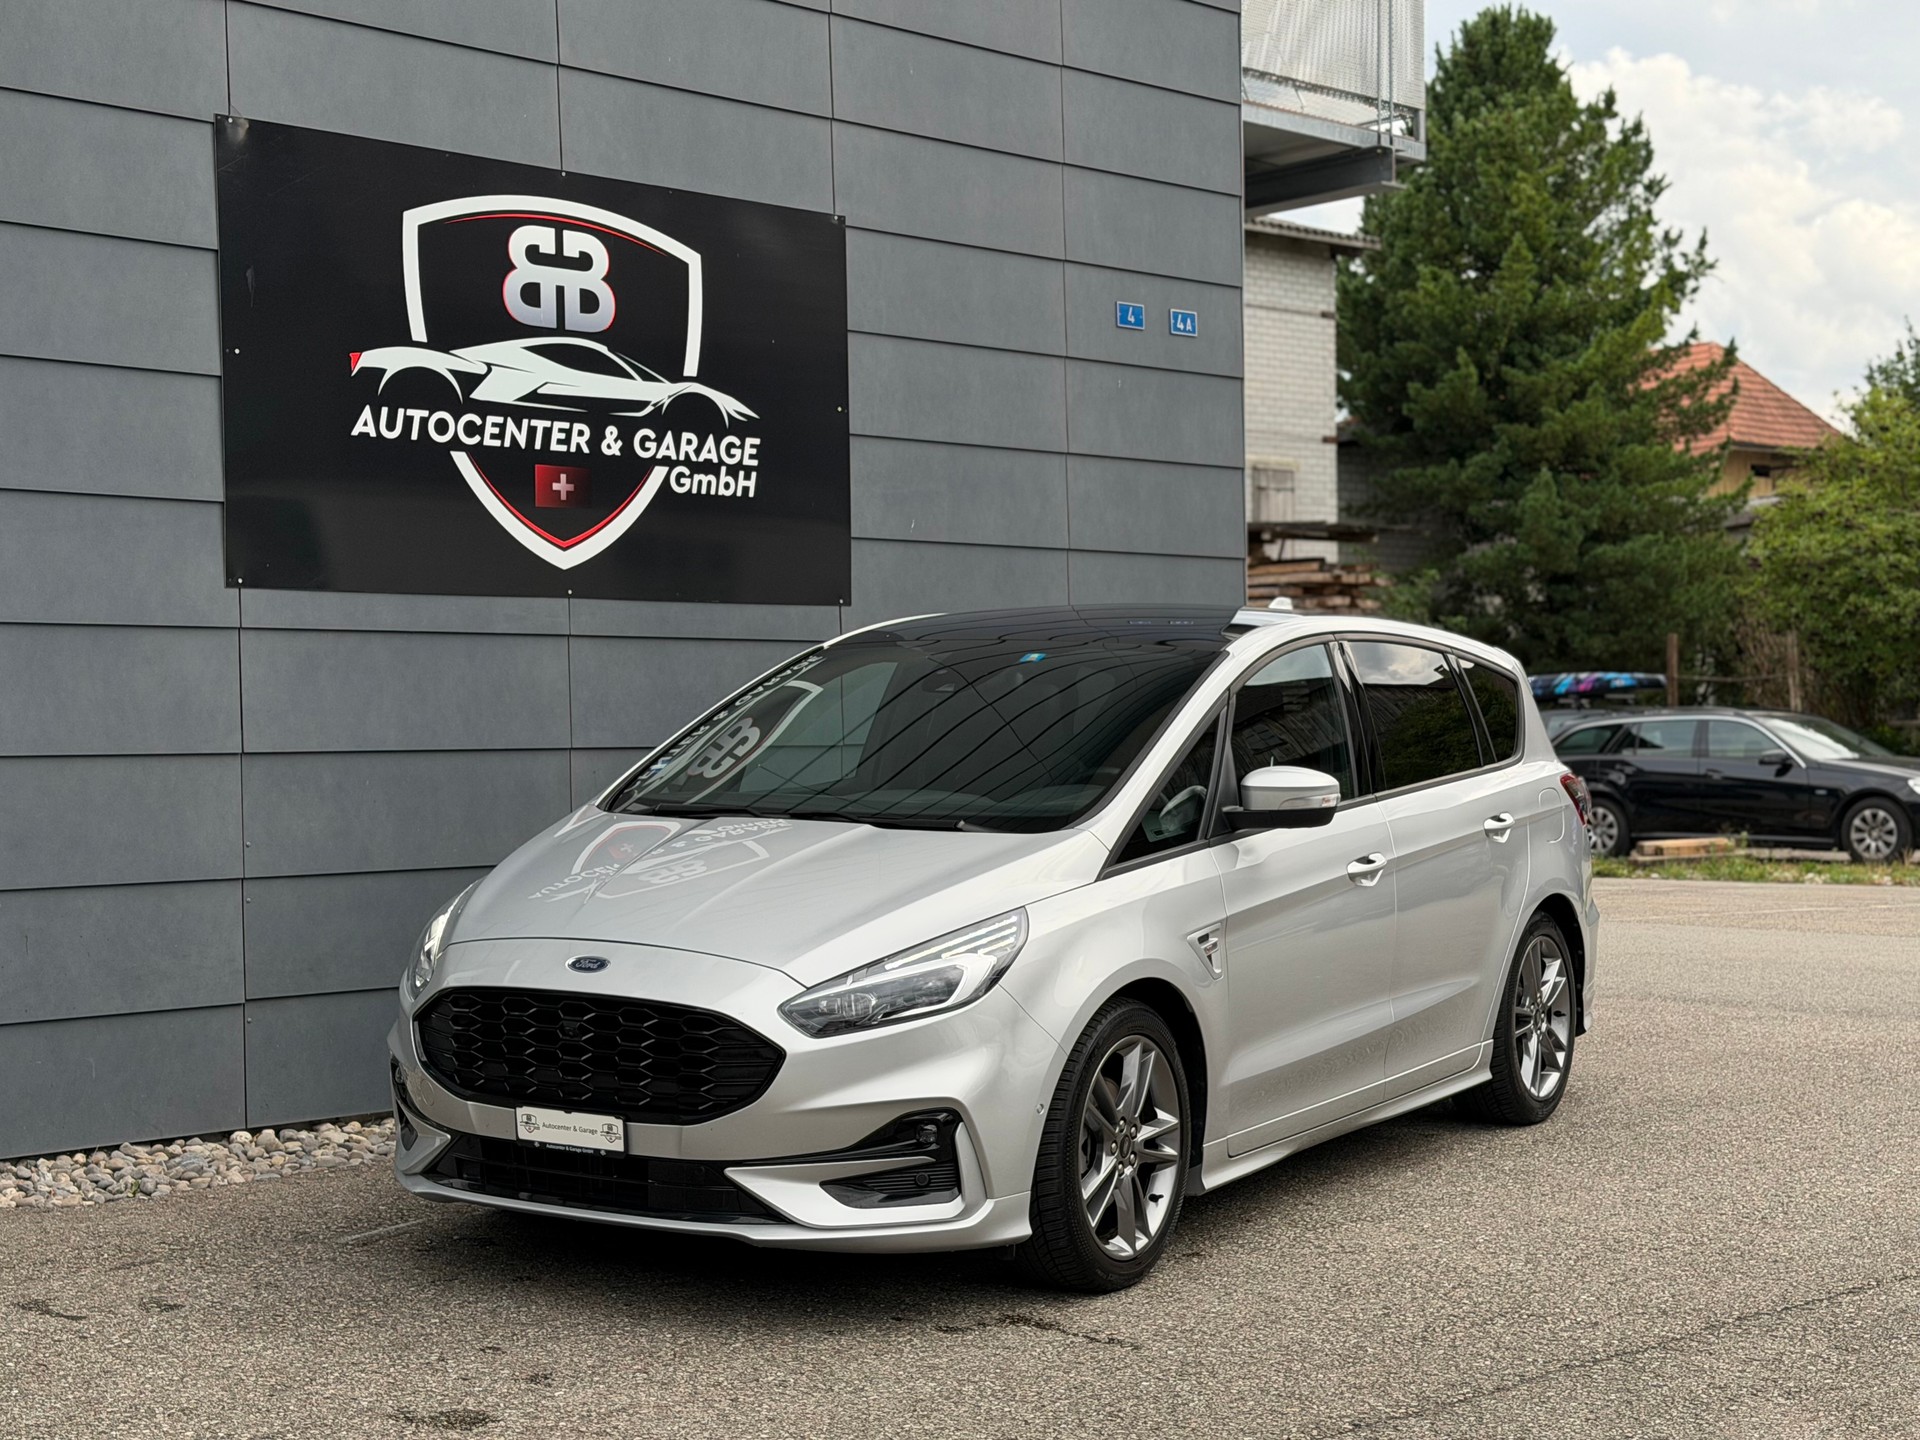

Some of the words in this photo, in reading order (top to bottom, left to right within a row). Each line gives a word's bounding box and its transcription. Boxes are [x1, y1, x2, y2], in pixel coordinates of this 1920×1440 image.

[1127, 306, 1136, 324] 4
[1176, 313, 1193, 332] 4A
[350, 404, 590, 454] AUTOCENTER
[601, 425, 623, 456] &
[633, 428, 761, 466] GARAGE
[669, 465, 757, 498] GmbH
[575, 959, 600, 969] Ford
[542, 1122, 572, 1132] Autocenter
[578, 1126, 598, 1136] Garage
